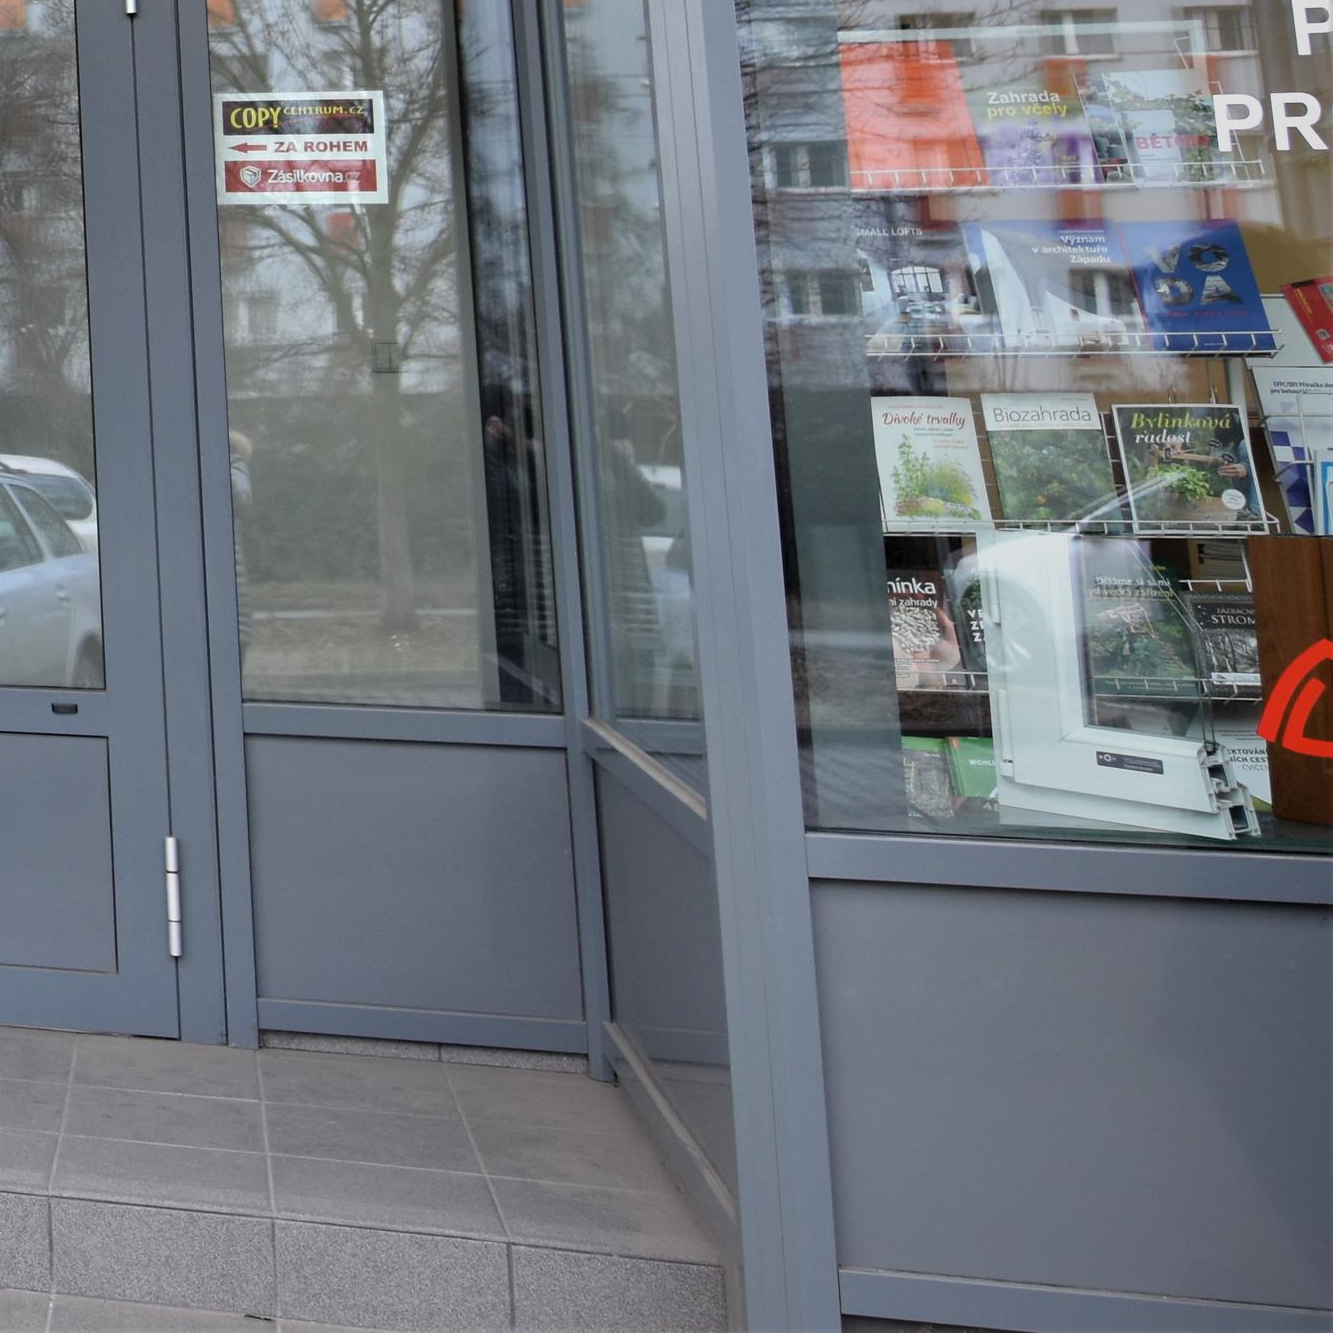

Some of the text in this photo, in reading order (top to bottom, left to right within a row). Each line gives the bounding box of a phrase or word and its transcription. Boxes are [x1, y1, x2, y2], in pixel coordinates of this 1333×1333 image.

[987, 90, 1061, 105] Zahrada
[231, 107, 282, 128] COPY
[986, 102, 1068, 118] pro včely
[274, 141, 368, 153] ZA ROHEM
[891, 227, 923, 236] LOFTS
[1060, 234, 1105, 246] Význam
[1041, 244, 1108, 254] architektuře
[1070, 254, 1112, 265] Západu
[883, 411, 965, 430] Divoké trvalky
[993, 407, 1092, 423] Biozahrada
[1130, 411, 1232, 430] Bylinková
[1134, 428, 1191, 444] radost
[899, 597, 938, 609] zahrady
